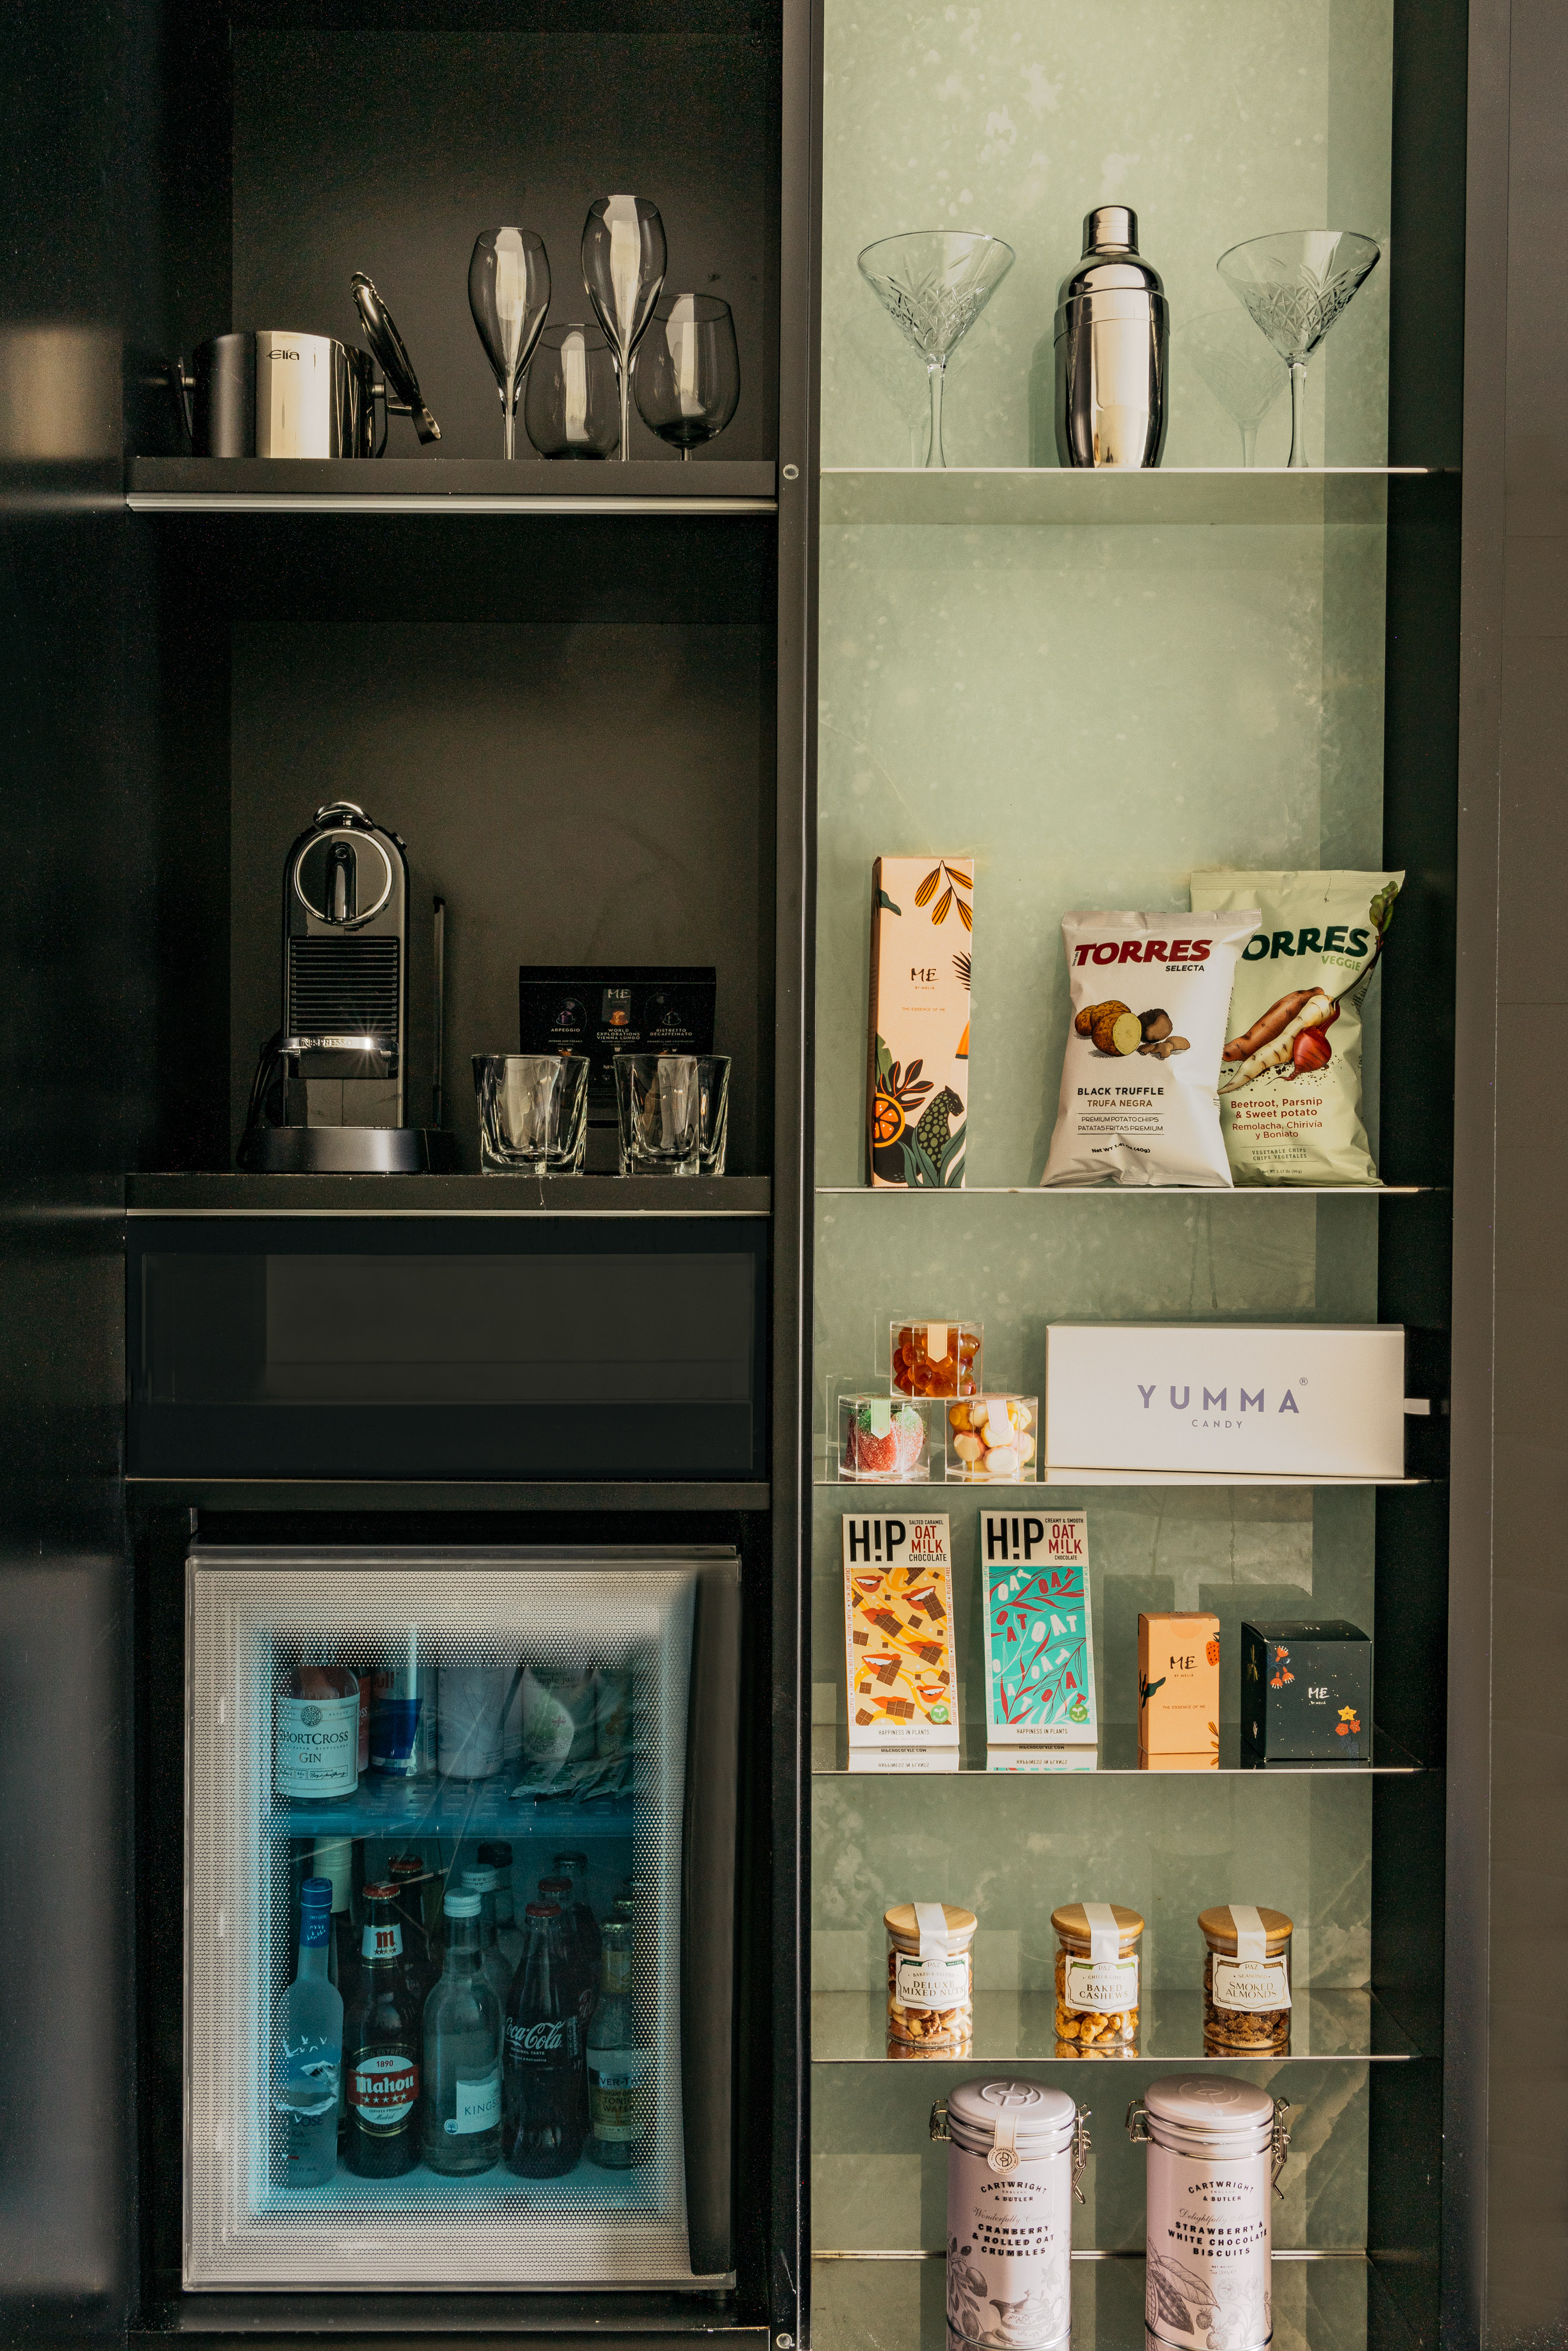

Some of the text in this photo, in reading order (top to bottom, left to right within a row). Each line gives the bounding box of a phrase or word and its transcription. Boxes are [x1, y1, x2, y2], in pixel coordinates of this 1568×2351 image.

[266, 349, 300, 360] Elia
[1241, 926, 1371, 961] ORRES
[1075, 939, 1213, 966] TORRES
[911, 968, 940, 982] ME
[608, 989, 631, 998] ME
[1231, 1099, 1278, 1109] Beetroot,
[1282, 1097, 1323, 1107] Parsnip
[1236, 1108, 1317, 1119] & Sweet potato
[1232, 1120, 1323, 1131] Remolacha, Chirivía
[1137, 1384, 1300, 1413] YUMMA
[1192, 1419, 1243, 1429] CANDY
[915, 1525, 937, 1539] OAT
[1052, 1524, 1075, 1539] OAT
[911, 1540, 944, 1553] M!LK
[1049, 1539, 1083, 1554] M!LK
[998, 1569, 1032, 1601] OAT
[1038, 1567, 1075, 1594] OAT
[1031, 1613, 1078, 1642] OAT
[1031, 1647, 1070, 1680] OAT
[1170, 1656, 1198, 1670] ME
[1308, 1687, 1330, 1699] ME
[299, 1752, 321, 1763] GIN
[903, 1986, 964, 1996] MIXED NUTS
[914, 1980, 955, 1989] DELUXE
[1229, 1981, 1273, 1991] SMOKED
[1079, 1991, 1128, 1999] CASHEWS
[1226, 1989, 1277, 1998] ALMONDS
[355, 2075, 414, 2093] Mahou
[981, 2181, 1047, 2194] CARTWRIGHT
[1188, 2181, 1255, 2194] CARTWRIGHT
[972, 2206, 1021, 2226] Wonderfully
[1179, 2207, 1227, 2226] Delightfully
[978, 2224, 1049, 2235] CRANBERRY
[1175, 2221, 1254, 2235] STRAWBERRY
[984, 2236, 1030, 2245] ROLLED
[1037, 2234, 1054, 2243] OAT
[1168, 2228, 1267, 2245] WHITE CHOCOLATE
[981, 2246, 1045, 2256] CRUMBLES
[1193, 2247, 1250, 2256] BISCUITS
